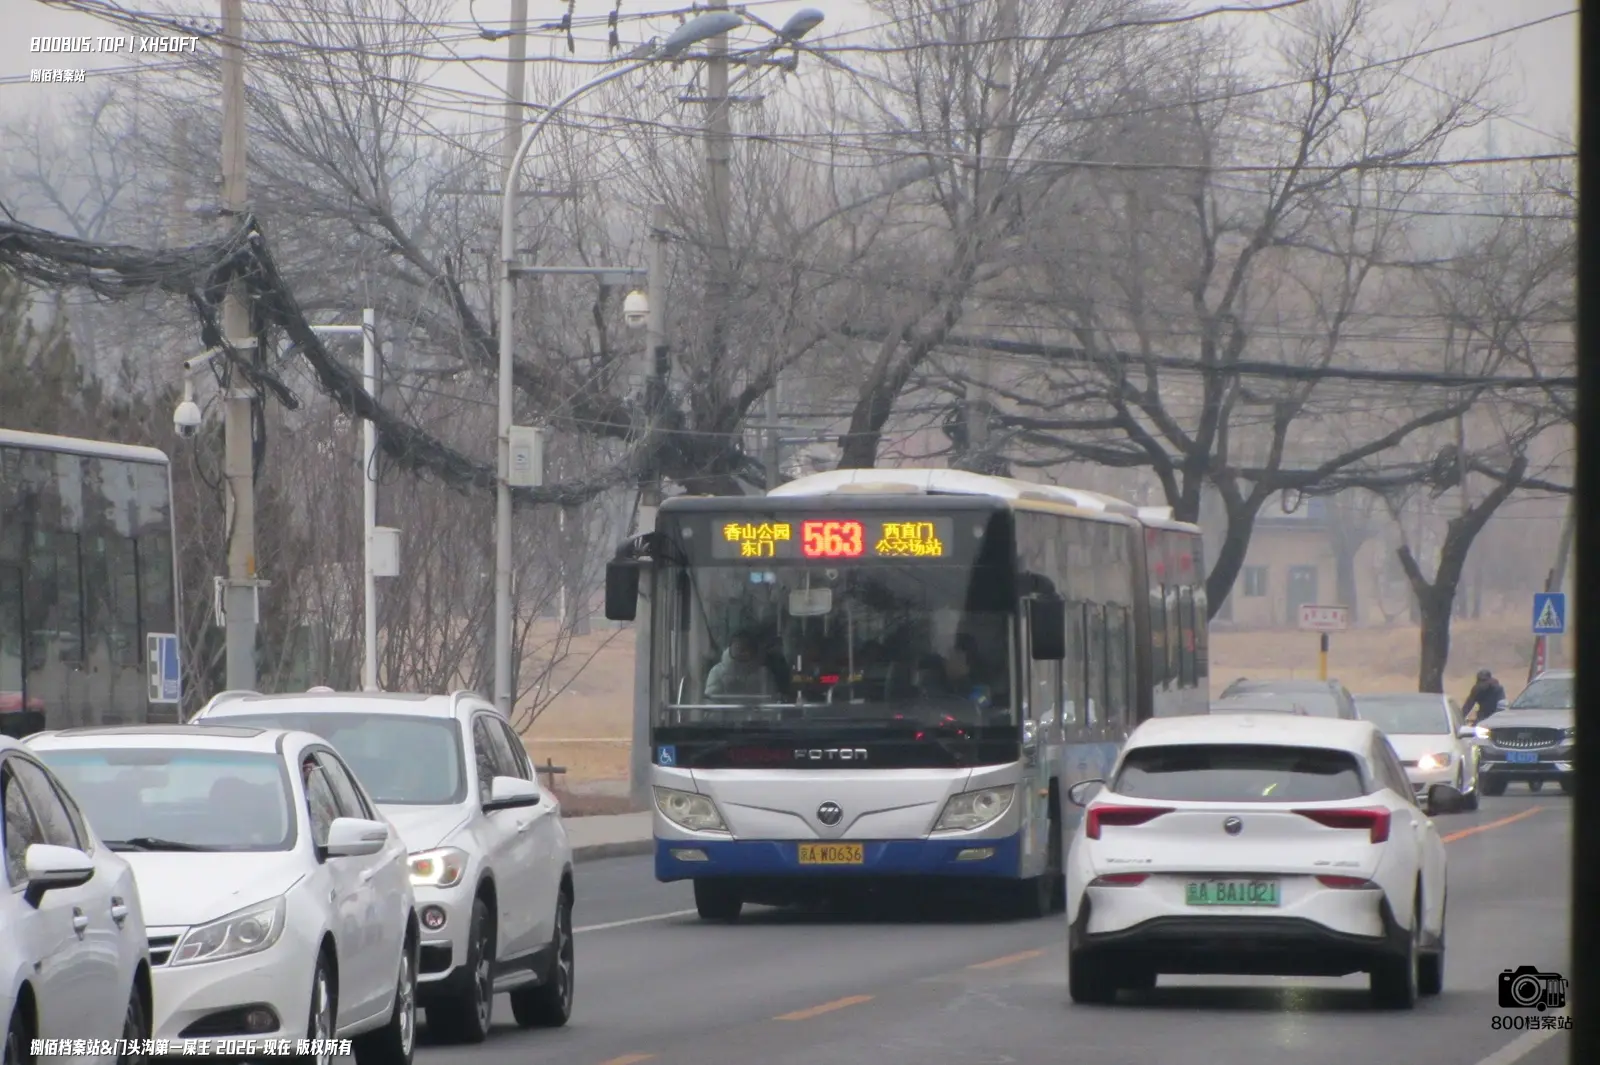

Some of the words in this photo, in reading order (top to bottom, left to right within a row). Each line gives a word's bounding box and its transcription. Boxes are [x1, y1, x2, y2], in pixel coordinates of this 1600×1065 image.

[723, 522, 793, 541] 香山公园
[803, 519, 864, 557] 563
[881, 521, 935, 540] 西直门
[740, 540, 775, 557] 东门
[875, 538, 943, 557] 公交场站
[794, 748, 868, 760] FOTON
